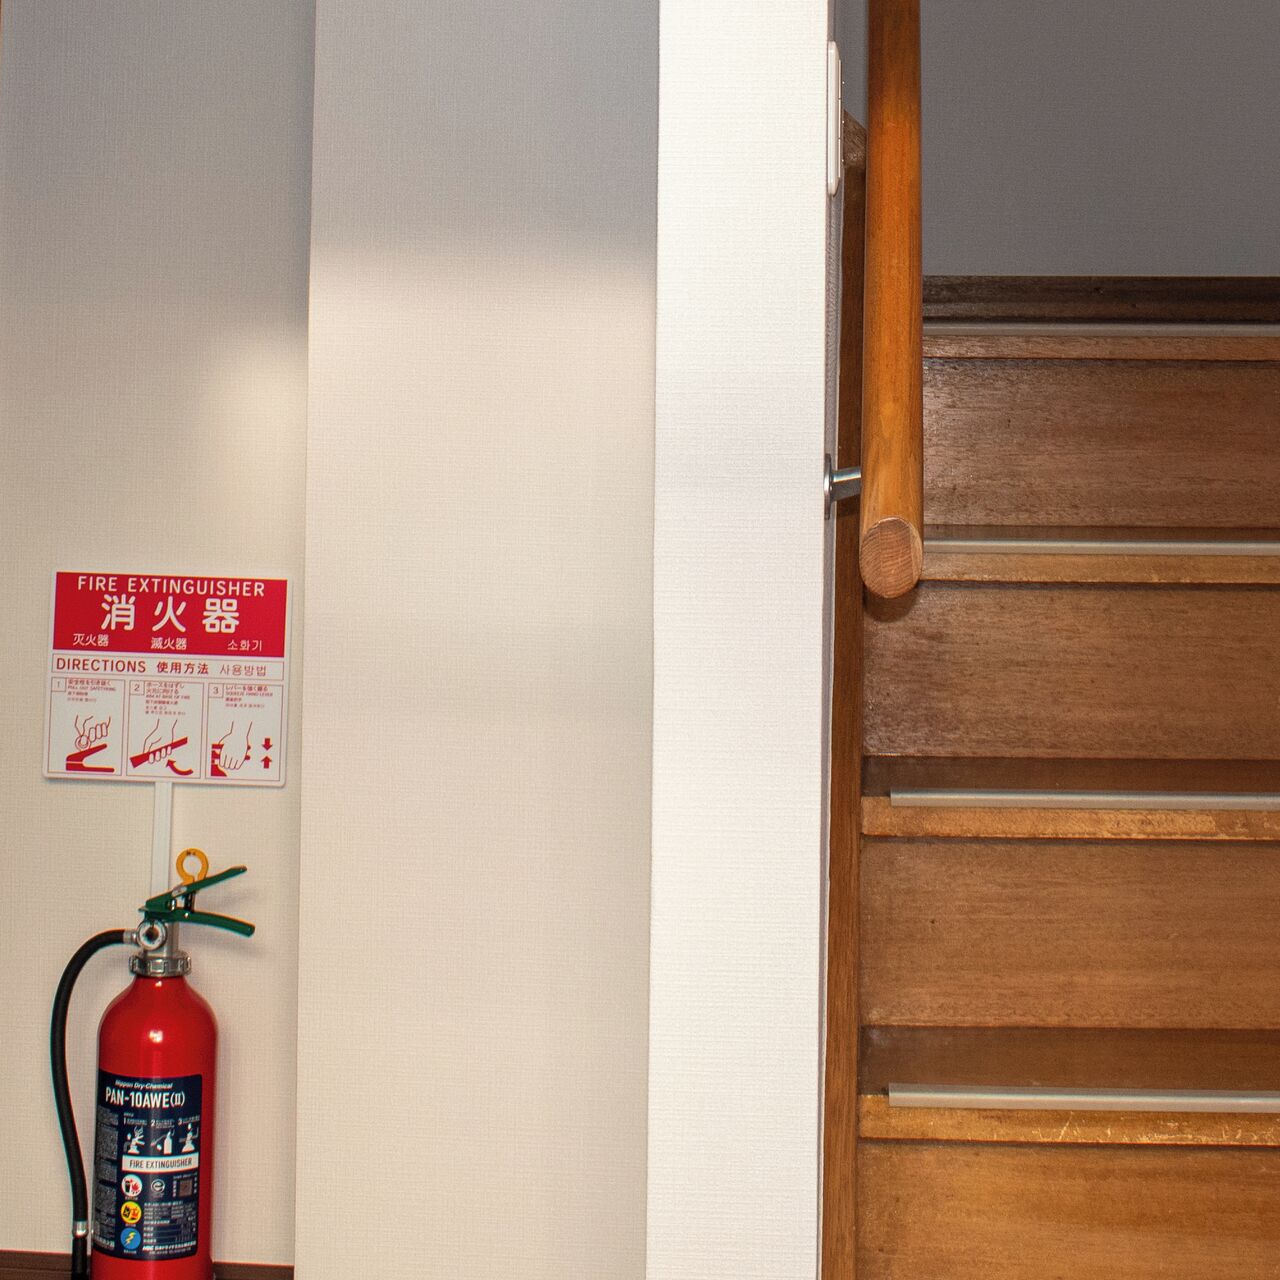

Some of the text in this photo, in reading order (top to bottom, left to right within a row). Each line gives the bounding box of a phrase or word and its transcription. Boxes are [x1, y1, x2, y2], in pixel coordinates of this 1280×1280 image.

[77, 575, 266, 597] FIRE EXTINGUISHER
[100, 593, 240, 634] 消火器
[72, 632, 110, 647] 灭火器
[226, 638, 263, 652] 소화기
[55, 657, 147, 674] DIRECTIONS
[156, 660, 210, 675] 使用方法
[219, 663, 267, 677] 사용방법
[133, 683, 140, 692] 2
[212, 686, 219, 695] 3
[129, 1157, 193, 1169] FIRE EXTINGUISHER
